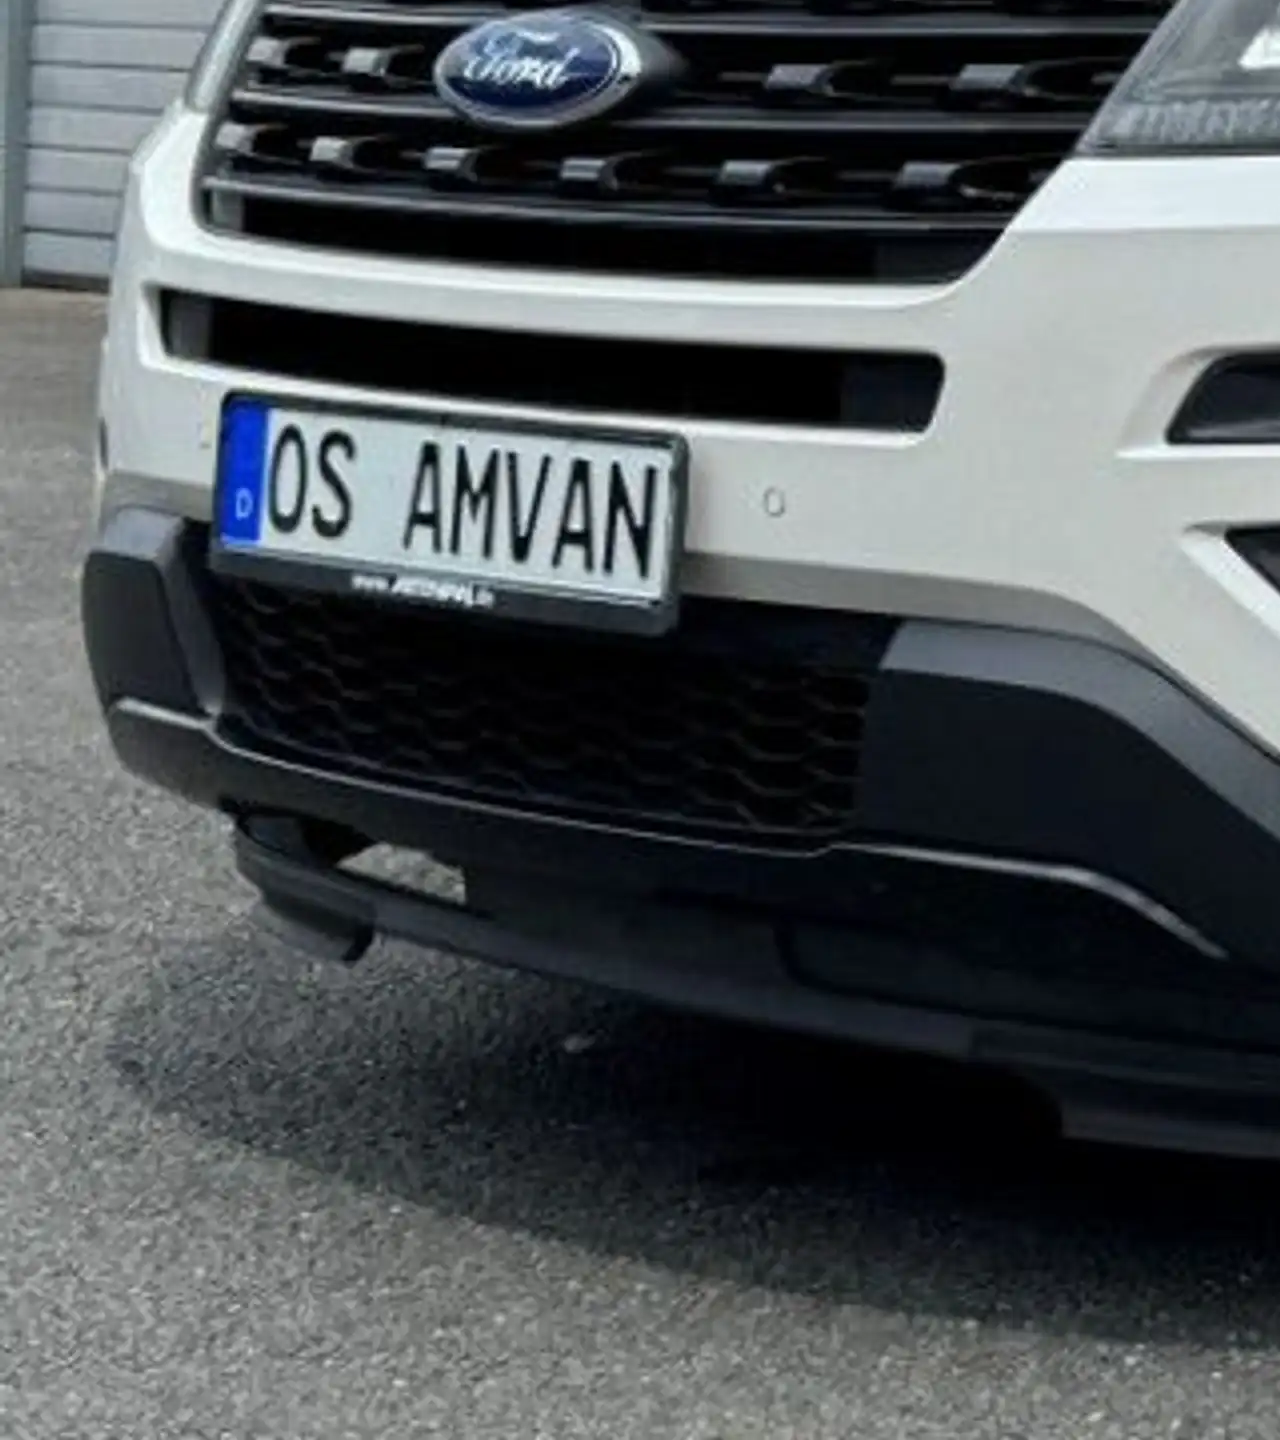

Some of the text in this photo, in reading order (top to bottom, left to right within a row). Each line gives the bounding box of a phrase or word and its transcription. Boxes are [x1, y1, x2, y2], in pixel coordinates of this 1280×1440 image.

[463, 26, 581, 91] Ford
[235, 487, 253, 520] D
[268, 424, 656, 578] OS AMVAN
